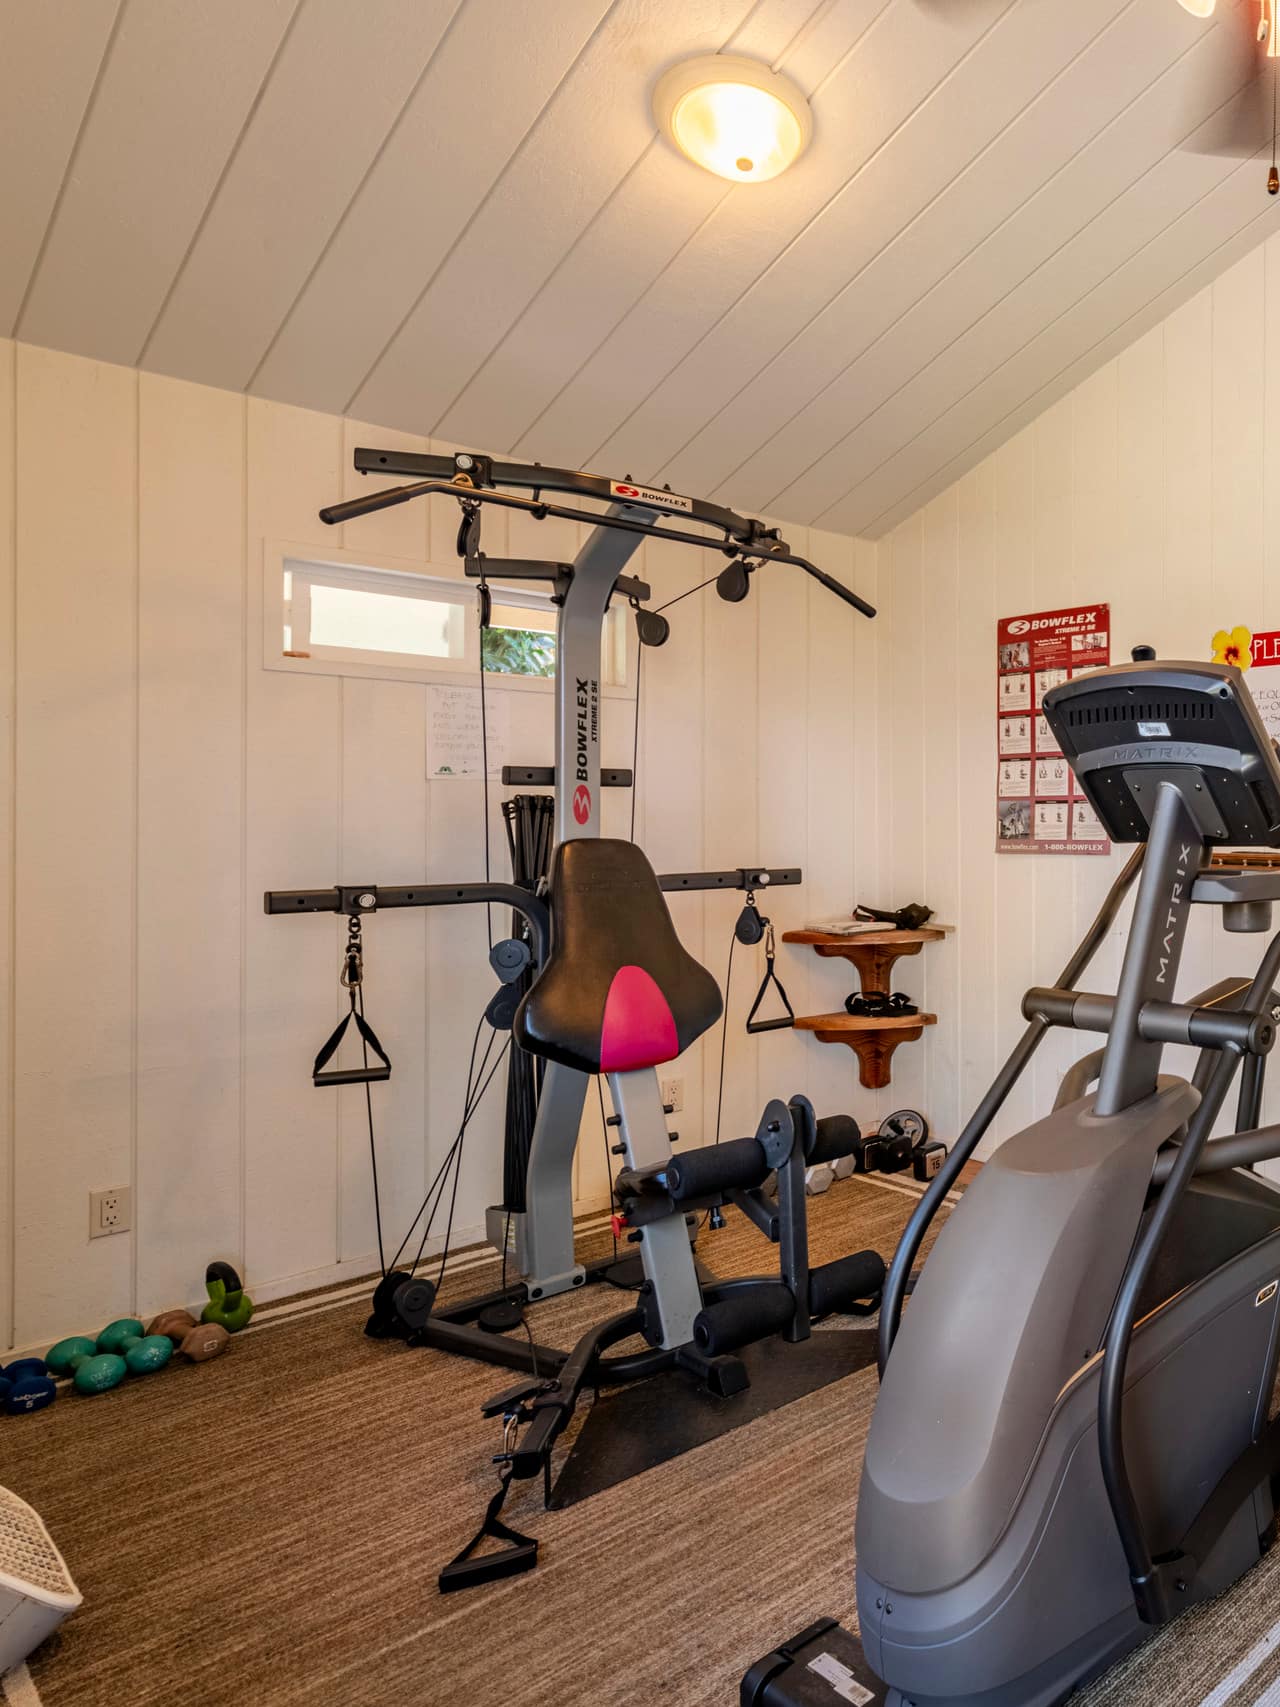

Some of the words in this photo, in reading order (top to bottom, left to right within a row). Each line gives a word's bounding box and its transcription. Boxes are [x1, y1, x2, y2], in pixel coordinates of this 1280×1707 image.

[641, 492, 687, 507] BOWFLEX
[1031, 612, 1097, 630] BOWFLEX
[591, 680, 598, 693] SE
[576, 678, 588, 781] BOWFLEX
[1112, 746, 1201, 761] MATRIX
[1044, 843, 1104, 851] 1-800-BOWFLEX
[1155, 843, 1191, 984] MATRIX
